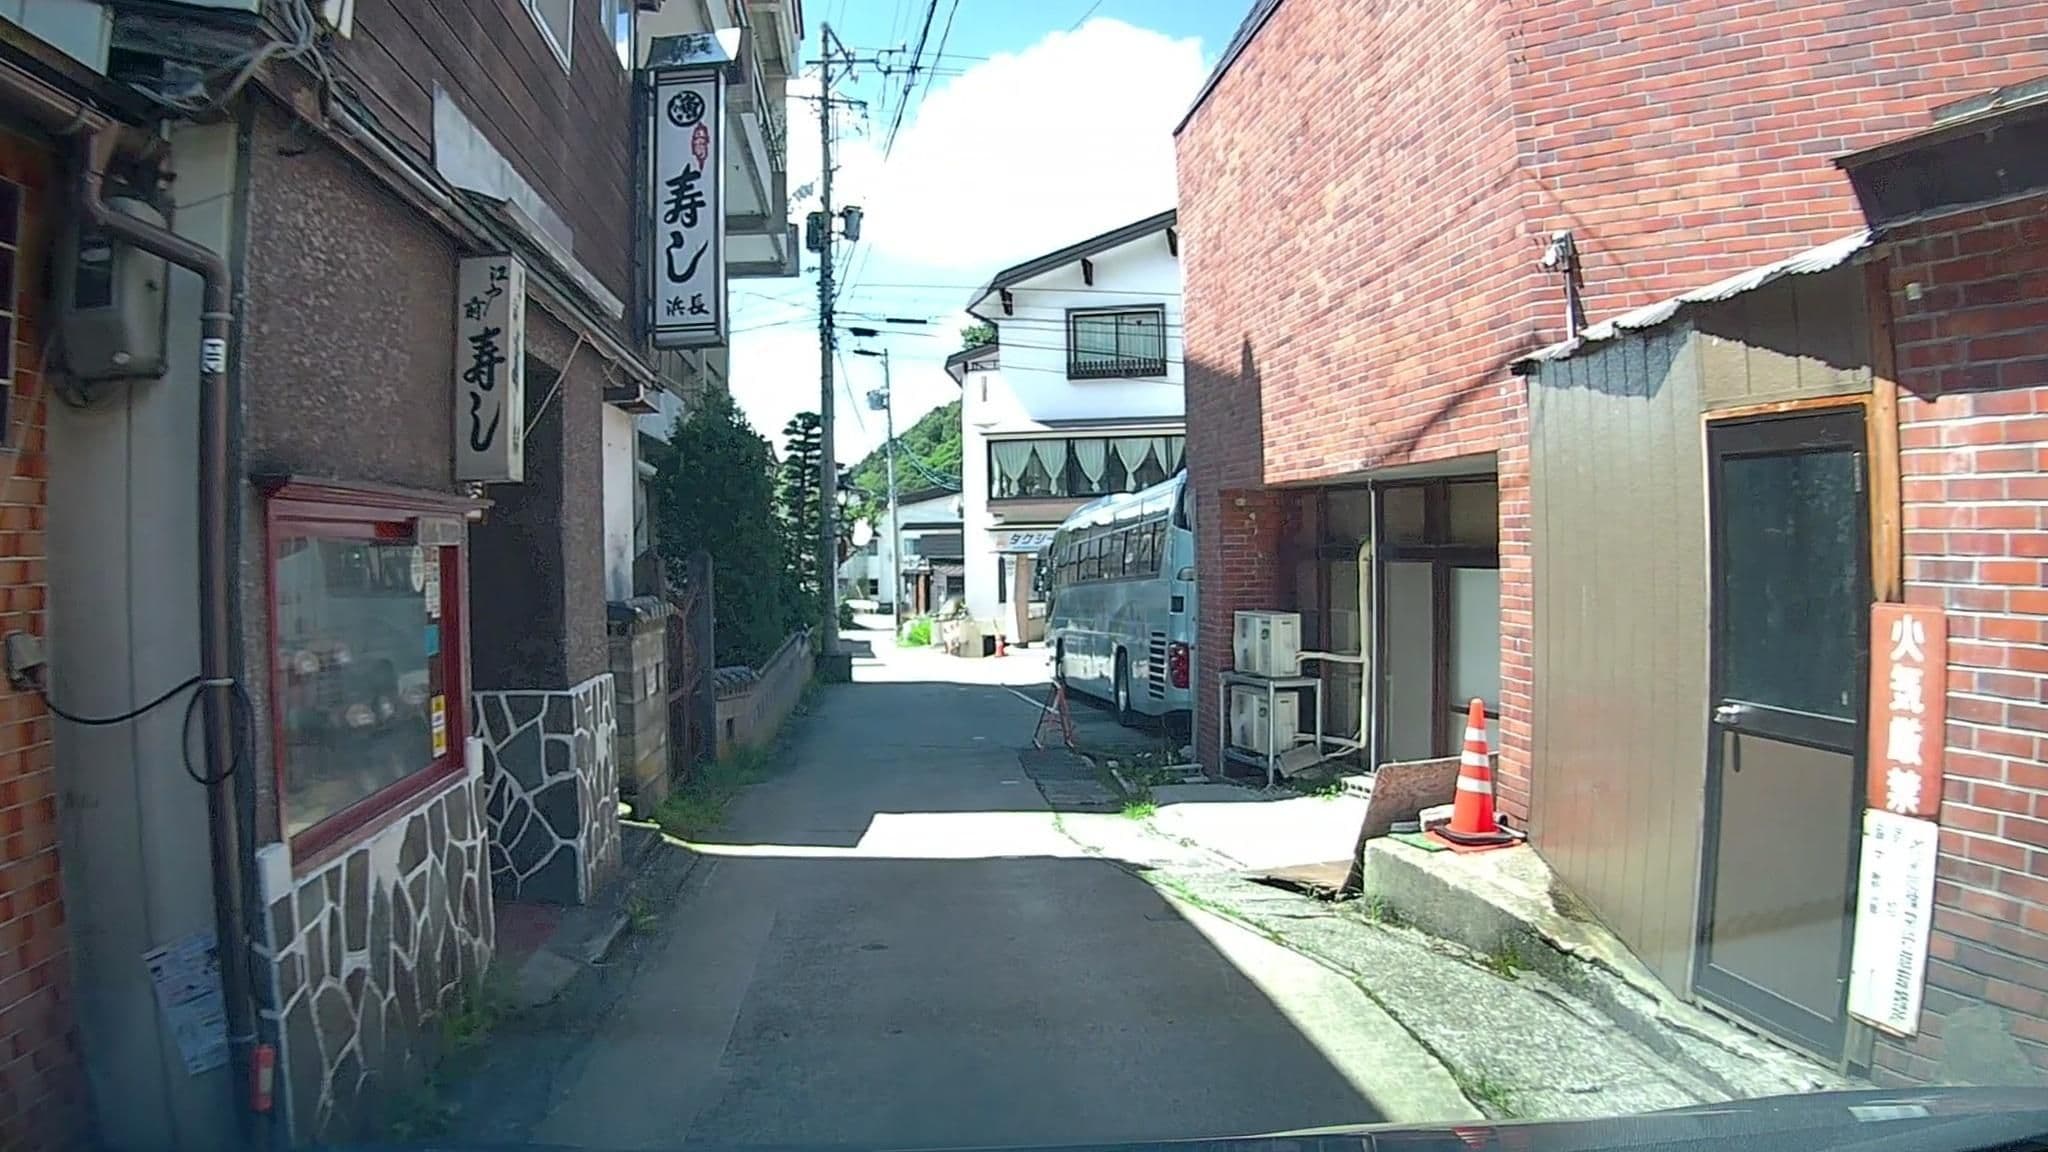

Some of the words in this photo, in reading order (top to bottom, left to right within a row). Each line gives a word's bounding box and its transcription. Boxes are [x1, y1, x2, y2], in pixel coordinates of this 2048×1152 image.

[664, 163, 708, 283] 寿し
[666, 293, 710, 317] 浜長
[463, 326, 506, 452] 寿し
